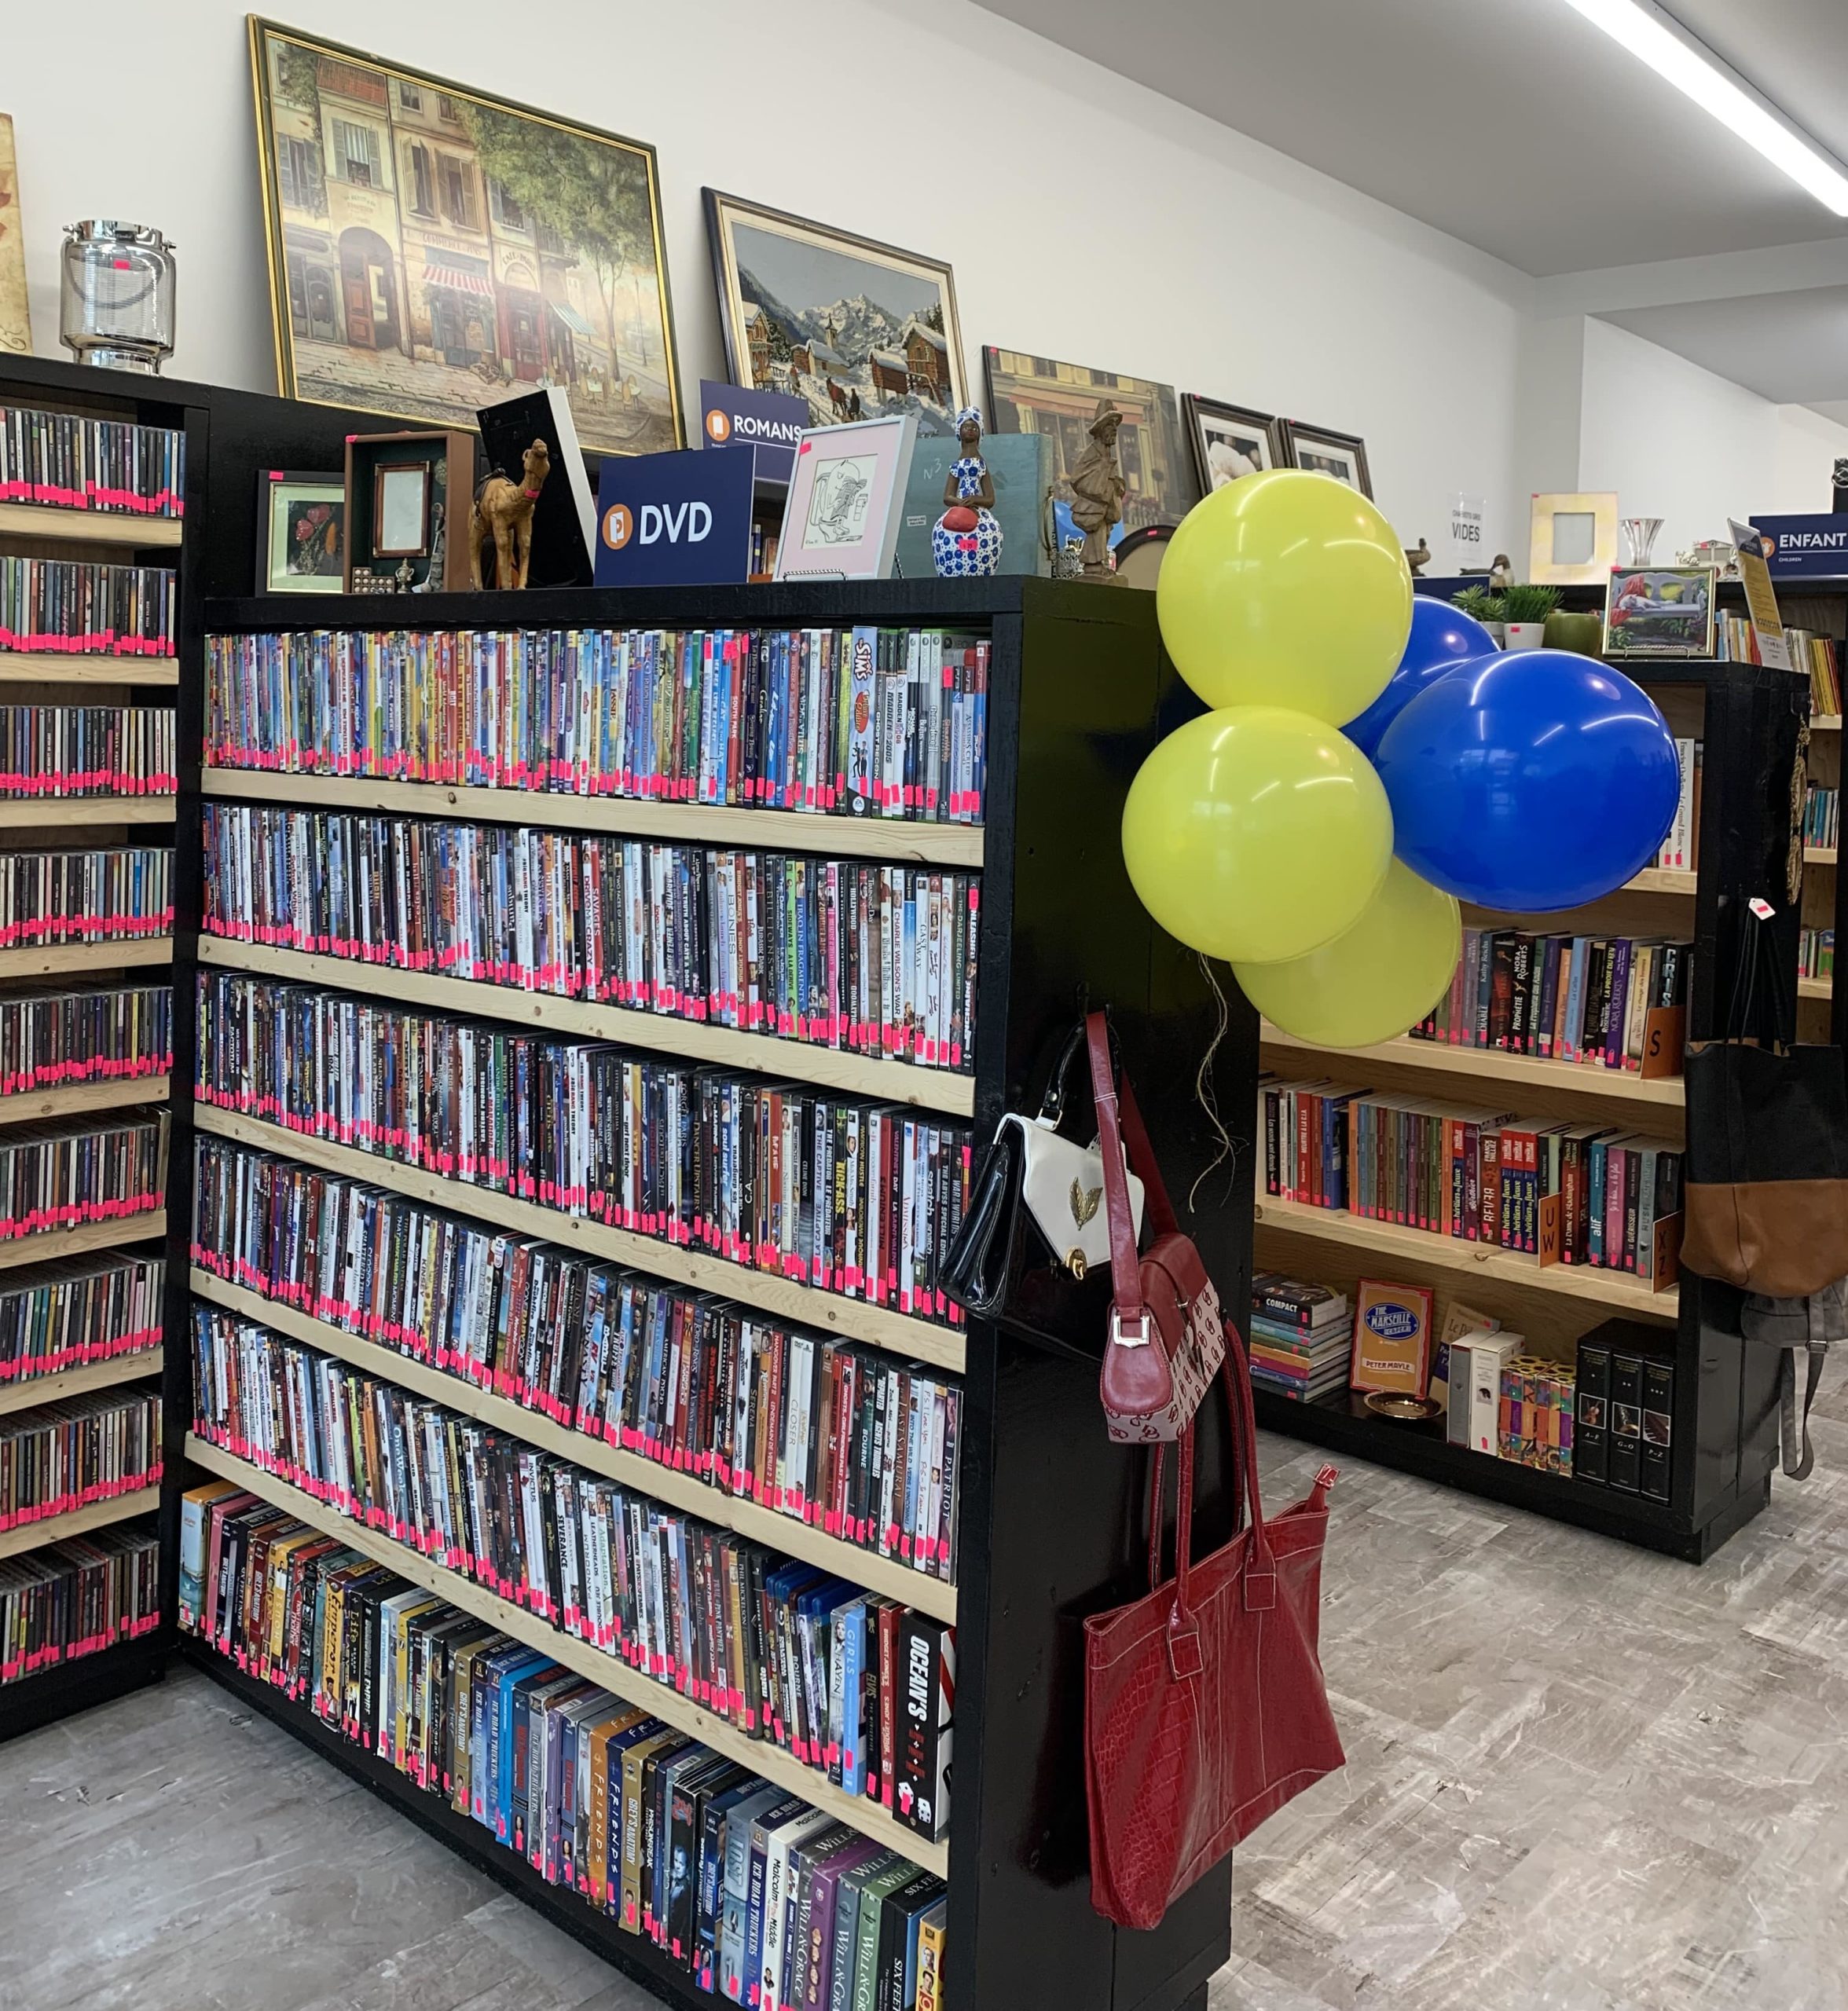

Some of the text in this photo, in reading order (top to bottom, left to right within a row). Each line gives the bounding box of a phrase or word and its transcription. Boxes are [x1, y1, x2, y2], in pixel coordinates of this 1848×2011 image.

[734, 415, 802, 438] ROMANS
[640, 502, 712, 544] DVD
[1452, 522, 1480, 542] VIDES
[1650, 1030, 1661, 1057] S
[835, 1161, 845, 1214] KICK-ASS
[952, 1179, 961, 1196] WAR
[1546, 1207, 1554, 1227] U
[1590, 1215, 1602, 1236] alif
[1543, 1234, 1554, 1254] W
[1266, 1298, 1297, 1313] COMPACT
[1366, 1361, 1387, 1369] PETER
[748, 1388, 757, 1428] SERENA
[789, 1400, 798, 1445] CLOSER
[860, 1429, 869, 1468] BOURNE
[942, 1456, 952, 1520] PATRIOT
[557, 1515, 567, 1567] SEVERANCE
[328, 1595, 342, 1673] Emperor
[846, 1629, 855, 1676] GIRLS
[792, 1655, 801, 1698] BOURNE
[908, 1636, 930, 1722] OCEAN'S
[595, 1773, 604, 1863] FRIENDS
[611, 1782, 621, 1874] FRIENDS
[626, 1824, 636, 1866] ANATOMY
[705, 1885, 715, 1916] ANATOMY
[771, 1859, 781, 1903] Malcolm
[748, 1861, 762, 1958] ICE ROAD TRUCKERS
[893, 1958, 903, 1981] SIX
